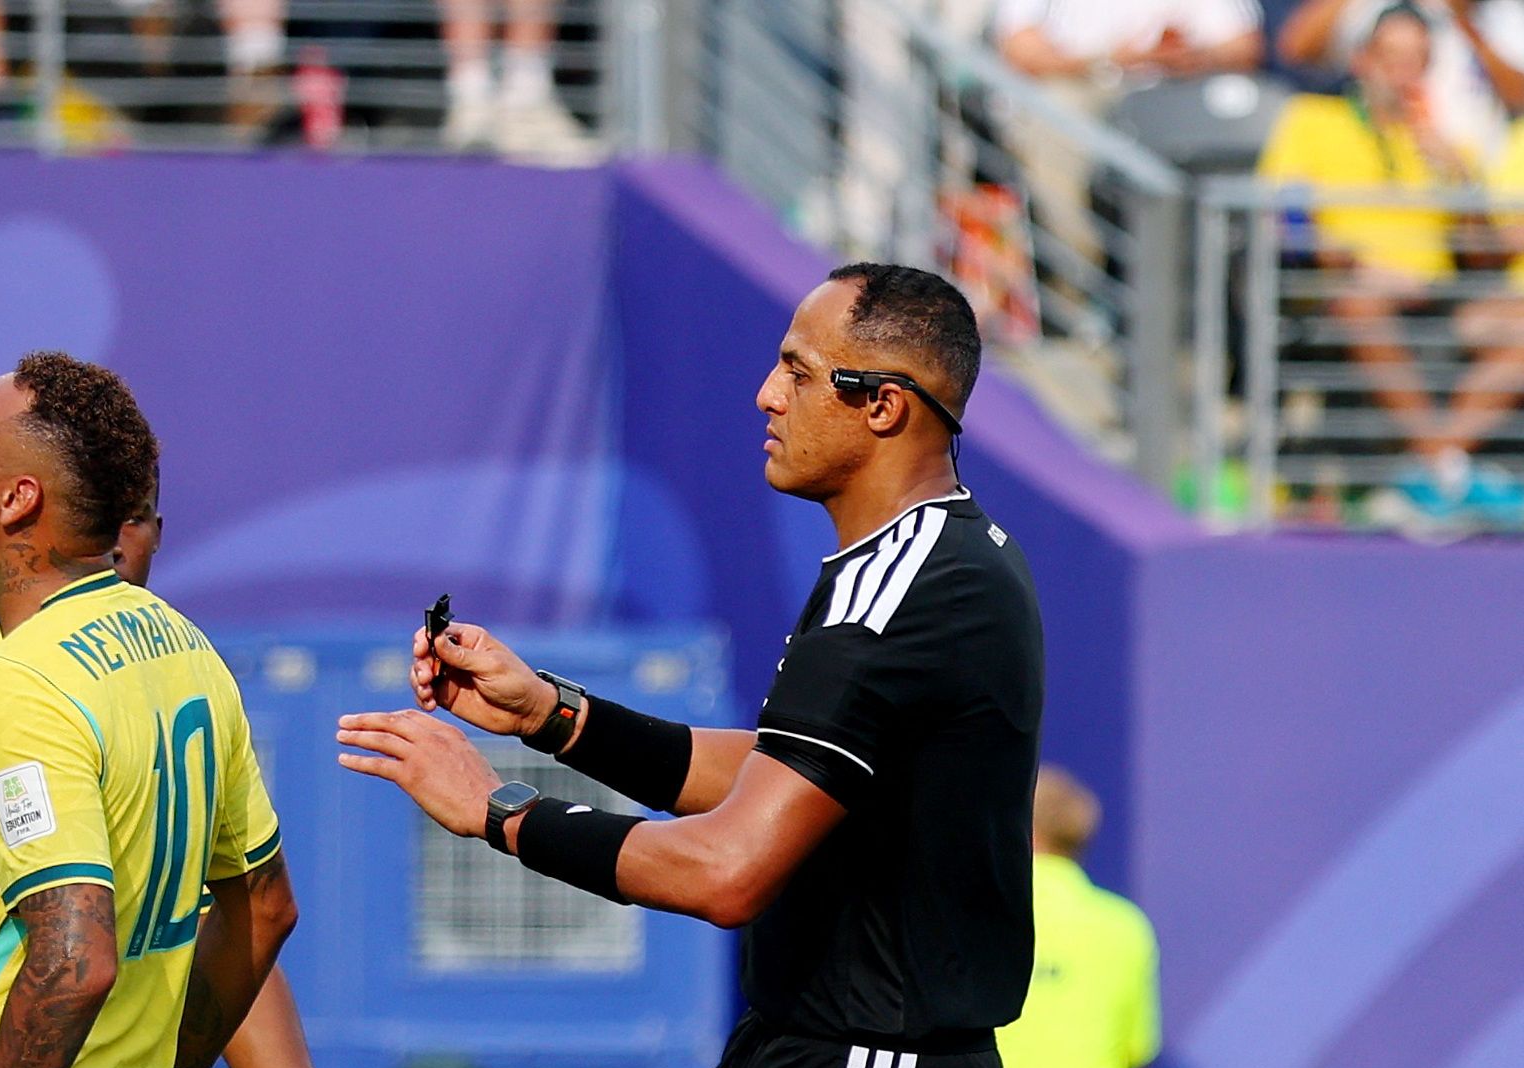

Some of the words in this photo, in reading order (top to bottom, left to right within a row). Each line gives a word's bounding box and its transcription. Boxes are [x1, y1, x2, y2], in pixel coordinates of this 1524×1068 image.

[840, 375, 860, 383] Lenovo
[58, 602, 182, 681] NEYMAR
[5, 809, 43, 832] EDUCATION
[125, 695, 217, 960] 10
